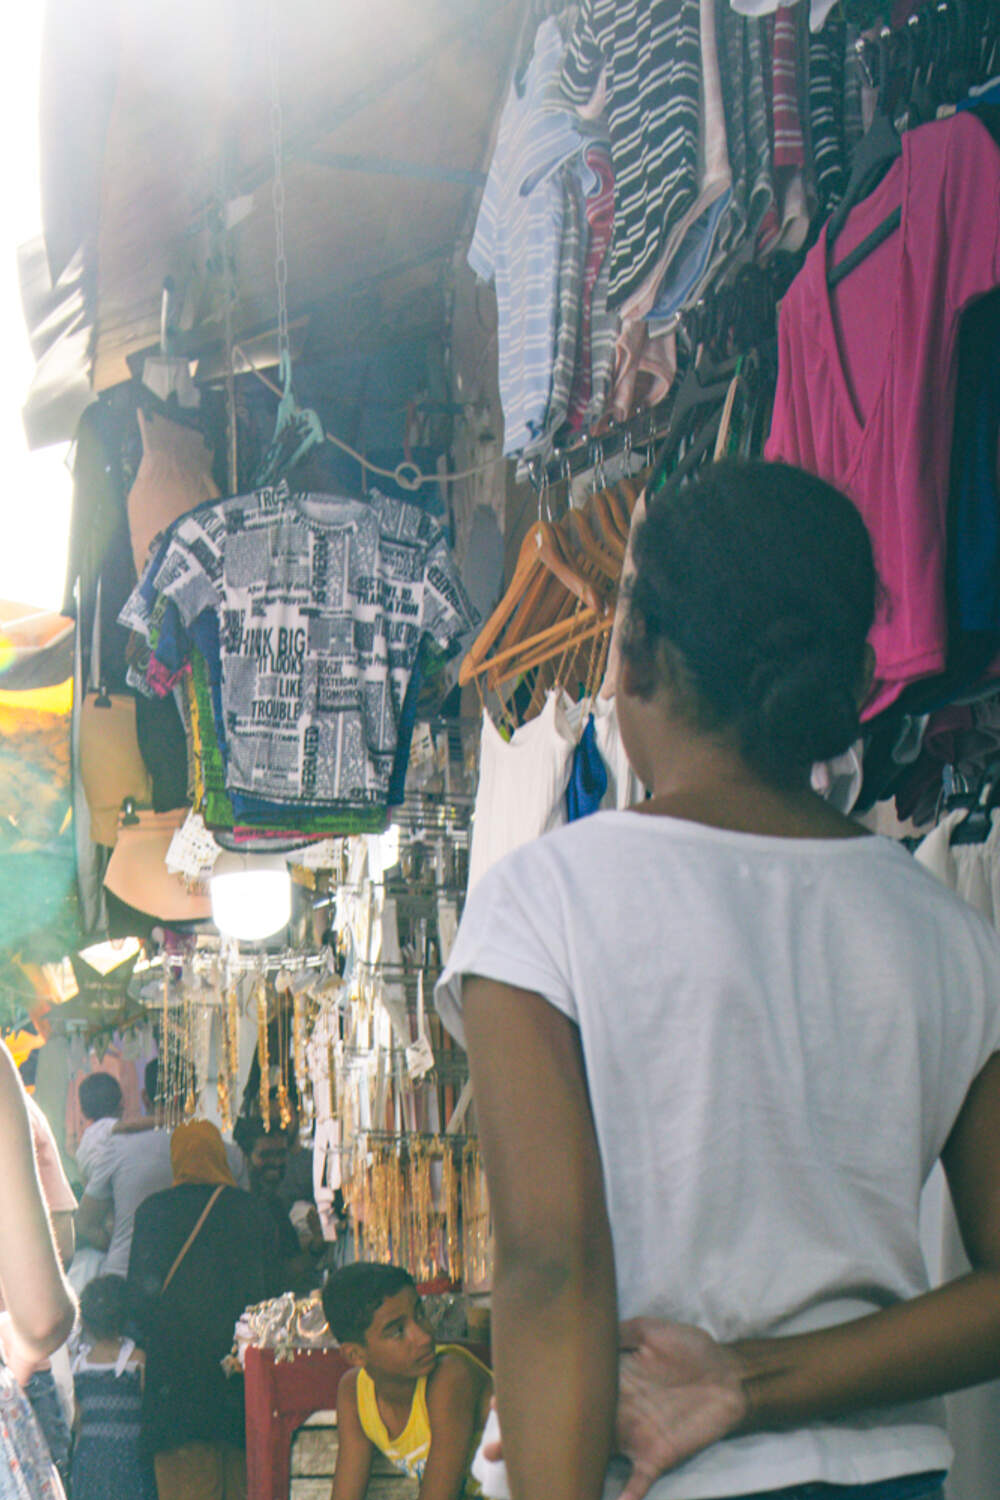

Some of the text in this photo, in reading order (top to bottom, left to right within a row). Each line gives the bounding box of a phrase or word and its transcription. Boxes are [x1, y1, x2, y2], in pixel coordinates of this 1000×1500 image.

[236, 626, 274, 657] HINK
[279, 678, 302, 697] LIKE
[251, 700, 302, 720] TROUBLE
